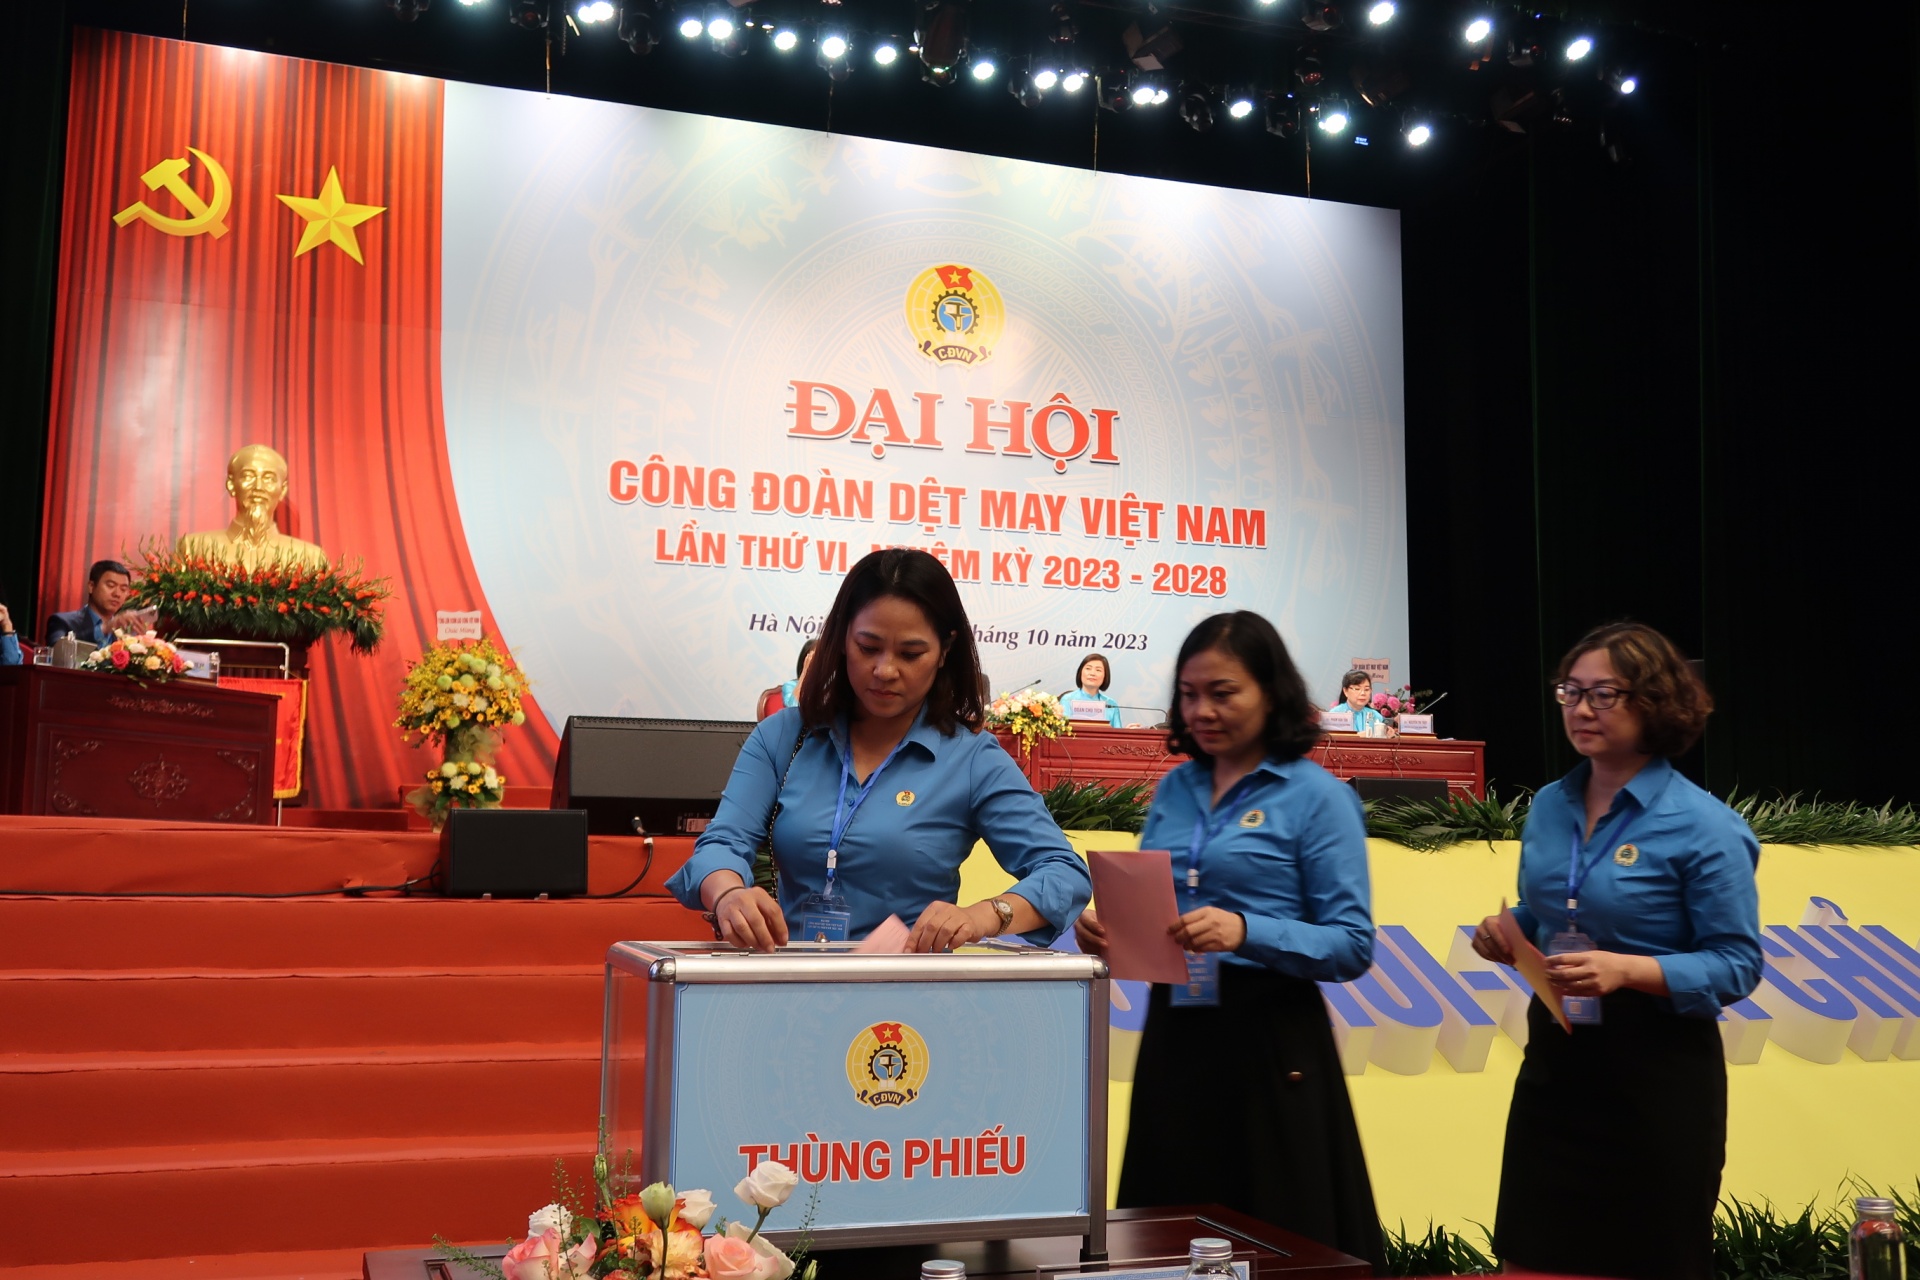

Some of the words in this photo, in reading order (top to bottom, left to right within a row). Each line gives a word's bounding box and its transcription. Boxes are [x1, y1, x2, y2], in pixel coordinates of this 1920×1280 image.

[937, 346, 973, 362] CĐVN
[785, 380, 942, 457] ĐẠI
[966, 392, 1119, 472] HỘI
[609, 454, 736, 509] CÔNG
[751, 468, 874, 519] ĐOÀN
[889, 476, 967, 533] DỆT
[980, 489, 1067, 533] MAY
[1080, 492, 1164, 547] VIỆT
[1176, 503, 1266, 547] NAM
[656, 519, 726, 565] LẦN
[738, 531, 809, 570] THỨ
[992, 546, 1033, 584] KỲ
[1043, 555, 1121, 590] 2023
[1131, 573, 1143, 581] -
[1152, 562, 1227, 596] 2028
[749, 613, 778, 632] Hà
[785, 615, 824, 640] Nội
[972, 624, 1019, 650] háng
[1028, 629, 1049, 646] 10
[1054, 629, 1097, 648] năm
[1102, 632, 1148, 651] 2023
[873, 1092, 902, 1104] CĐVN
[739, 1132, 891, 1183] THÙNG
[903, 1124, 1027, 1179] PHIẾU
